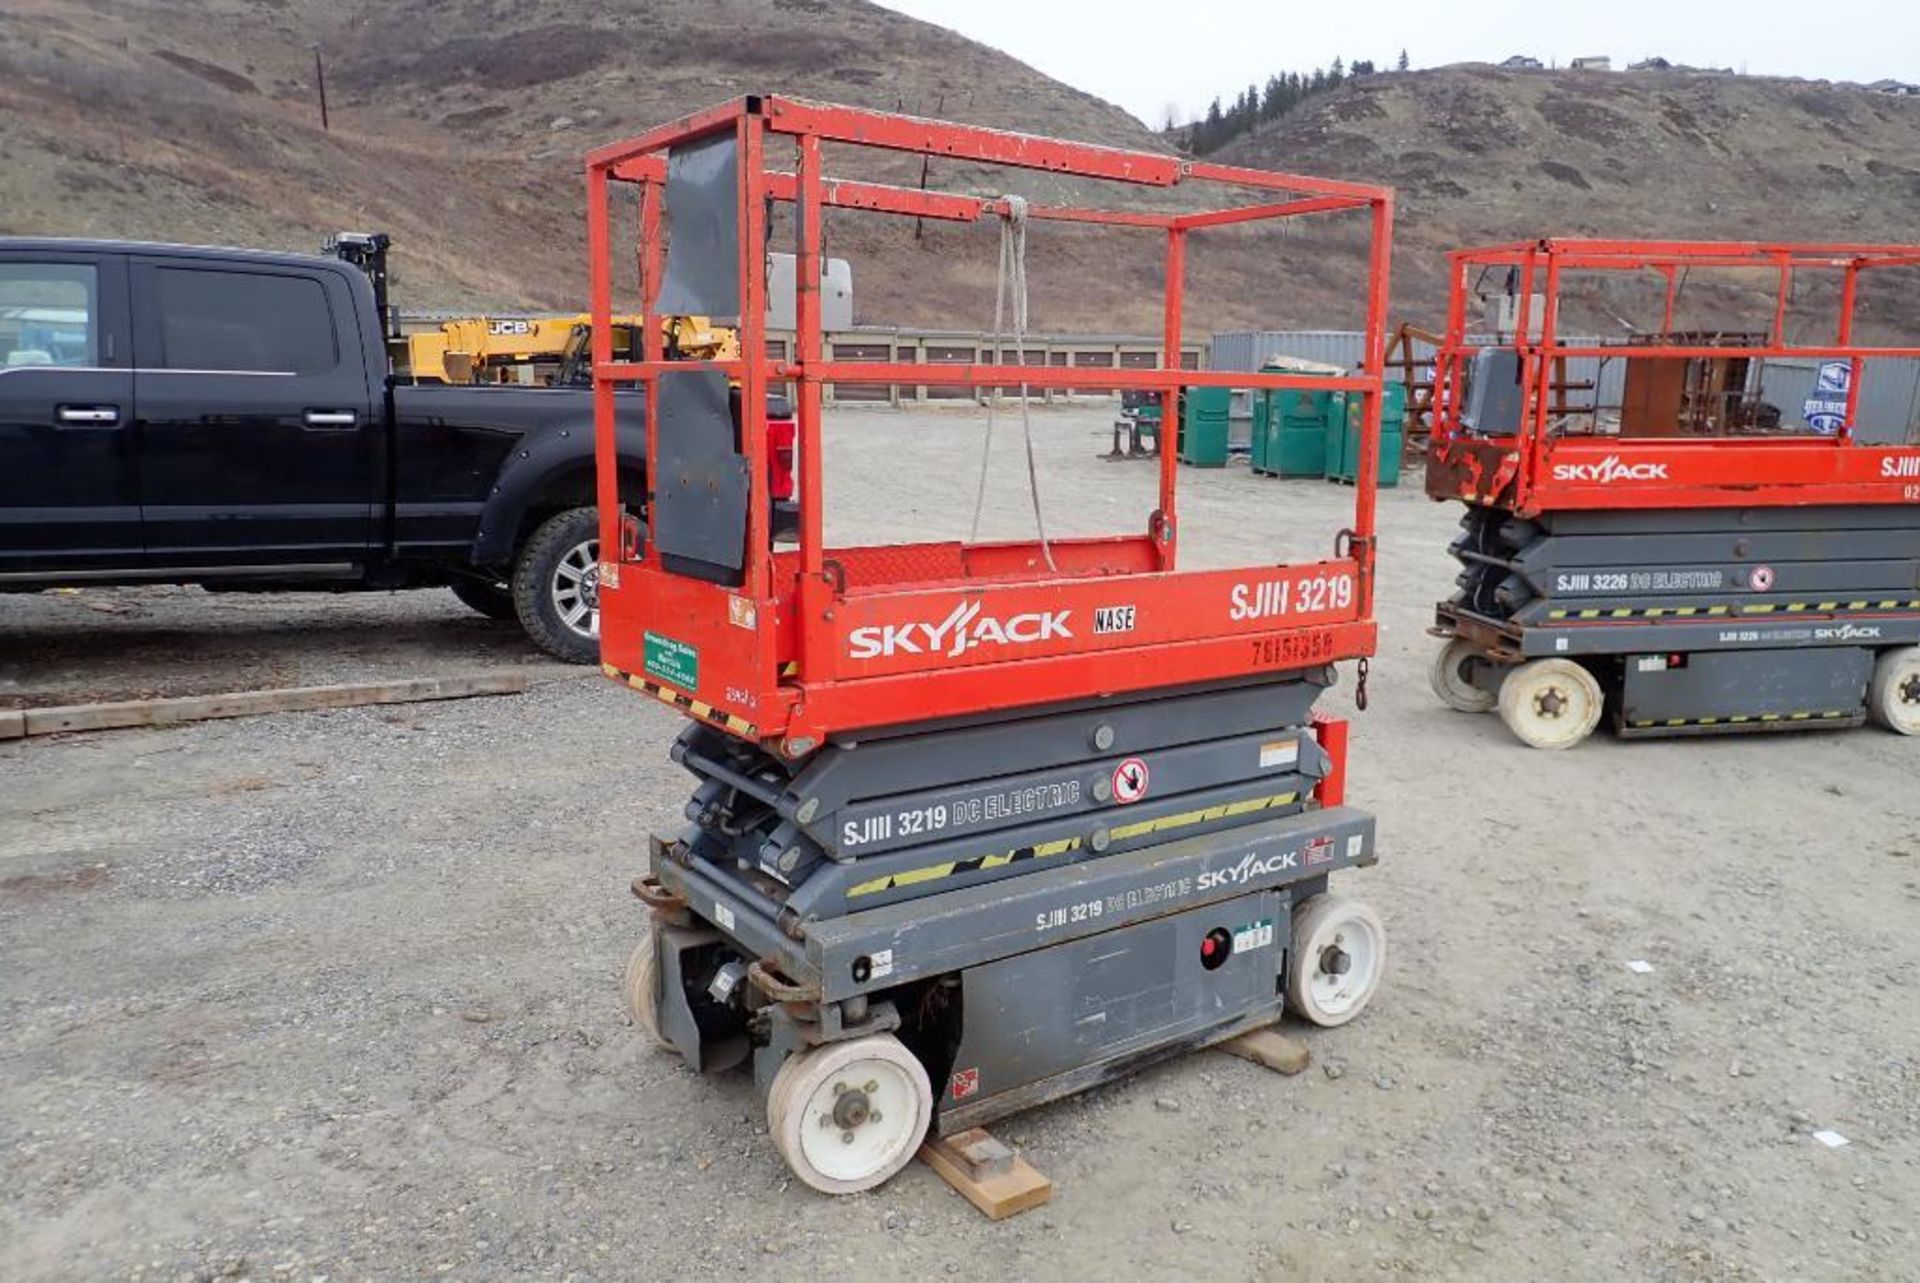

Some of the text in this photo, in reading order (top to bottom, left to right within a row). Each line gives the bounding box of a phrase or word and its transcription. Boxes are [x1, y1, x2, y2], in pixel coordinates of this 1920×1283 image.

[489, 320, 529, 335] JCB
[1552, 455, 1669, 484] SKYJACK
[1229, 574, 1352, 620] SJIII 3219
[1557, 574, 1590, 591] SJIII
[1592, 574, 1628, 590] 3226
[849, 599, 1074, 659] SKYJACK
[1094, 607, 1135, 633] NASE
[1814, 624, 1881, 640] SKYJACK
[843, 780, 1080, 846] SJIII 3219 DC ELECTRIC
[1036, 910, 1067, 931] SJIII
[1070, 899, 1103, 924] 3219
[1196, 852, 1298, 890] SKYJACK
